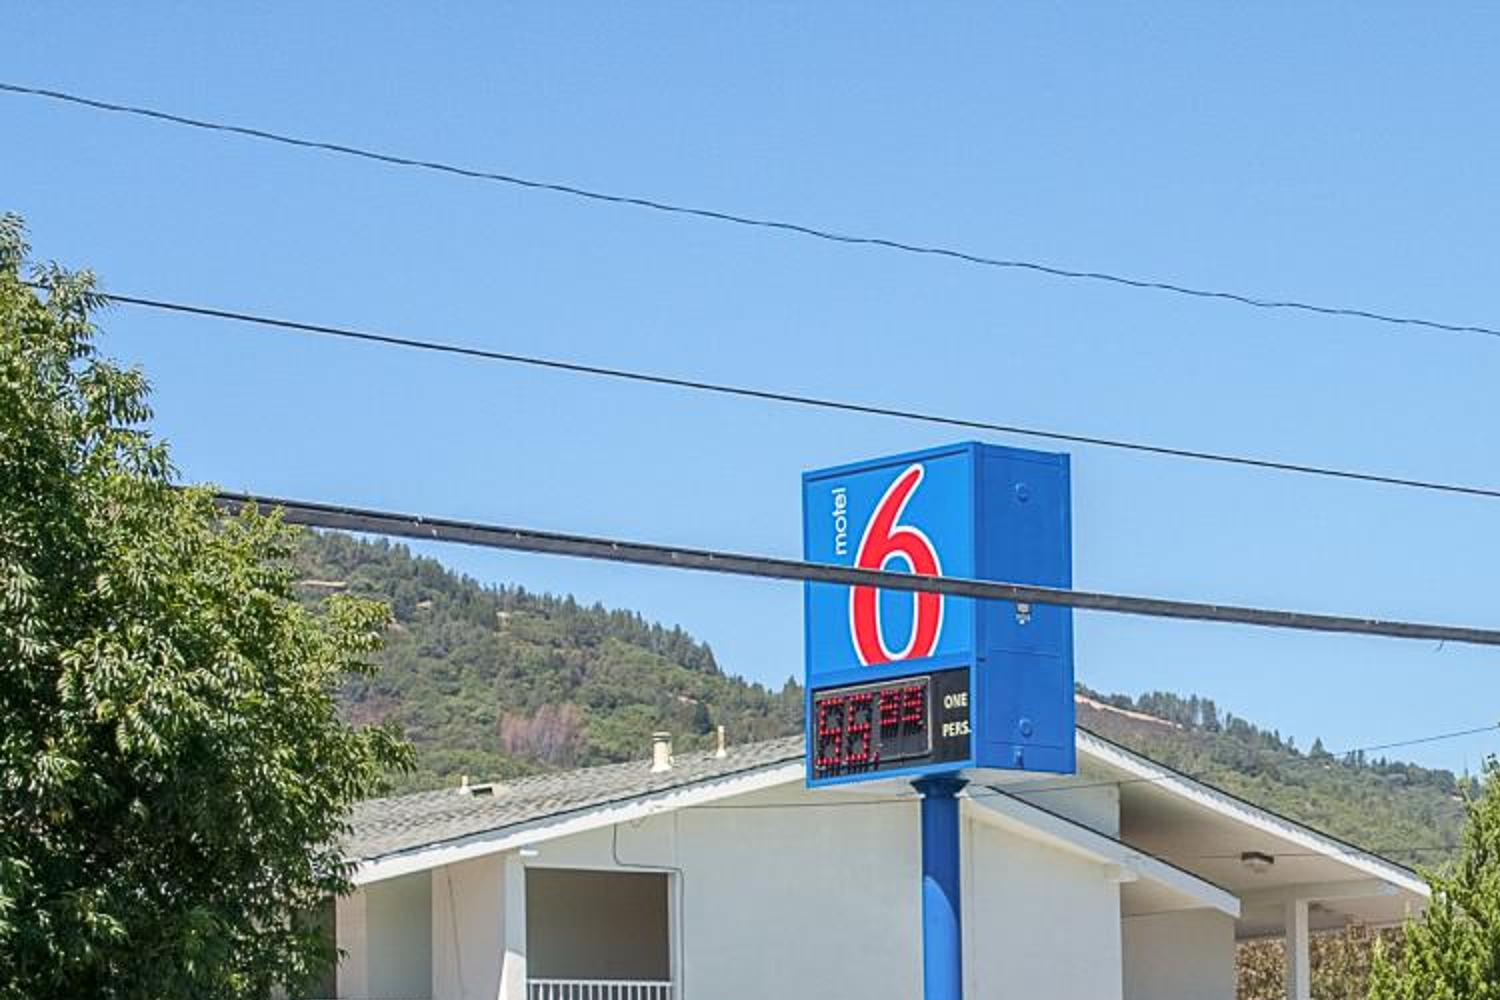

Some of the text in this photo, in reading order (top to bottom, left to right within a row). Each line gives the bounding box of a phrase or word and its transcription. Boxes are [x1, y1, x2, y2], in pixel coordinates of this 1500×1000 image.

[832, 464, 944, 666] motel 6
[943, 691, 968, 709] ONE
